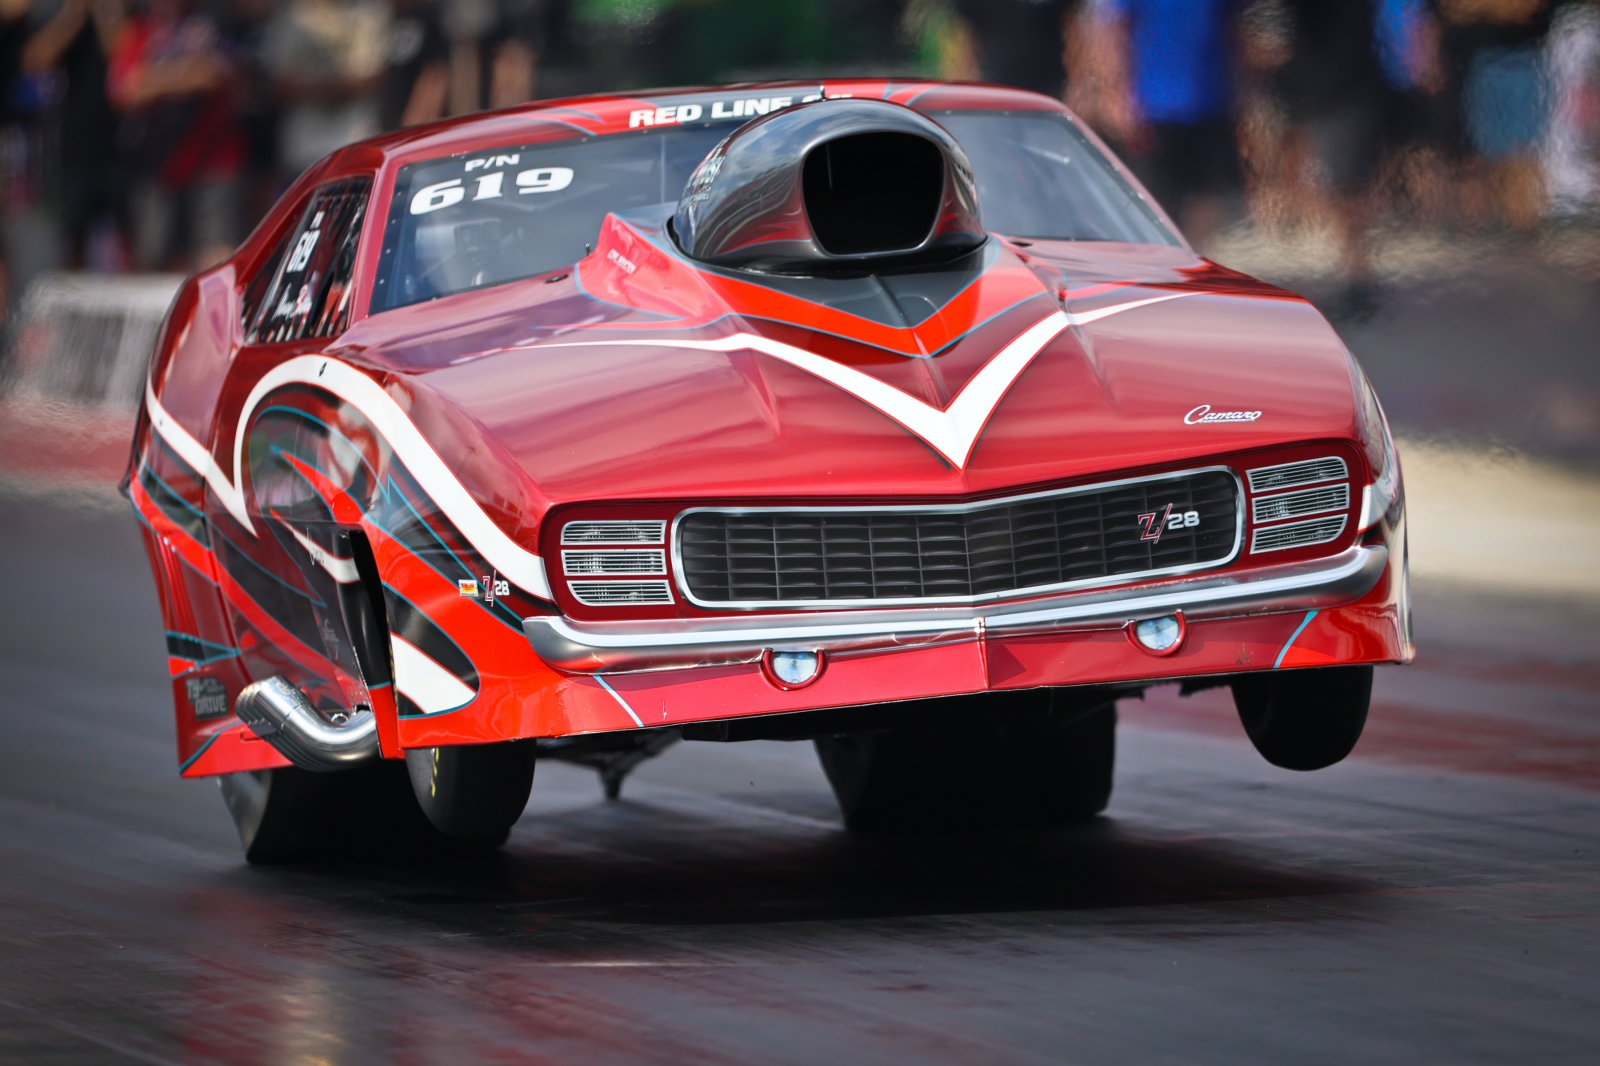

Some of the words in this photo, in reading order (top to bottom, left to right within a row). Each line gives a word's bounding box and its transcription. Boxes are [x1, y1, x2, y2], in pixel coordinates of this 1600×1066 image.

[629, 104, 702, 128] RED
[465, 153, 520, 172] P/N
[409, 167, 574, 216] 619
[286, 229, 321, 273] 619
[1183, 404, 1262, 425] Camaro
[1137, 503, 1200, 544] Z/28
[482, 569, 510, 607] Z/28
